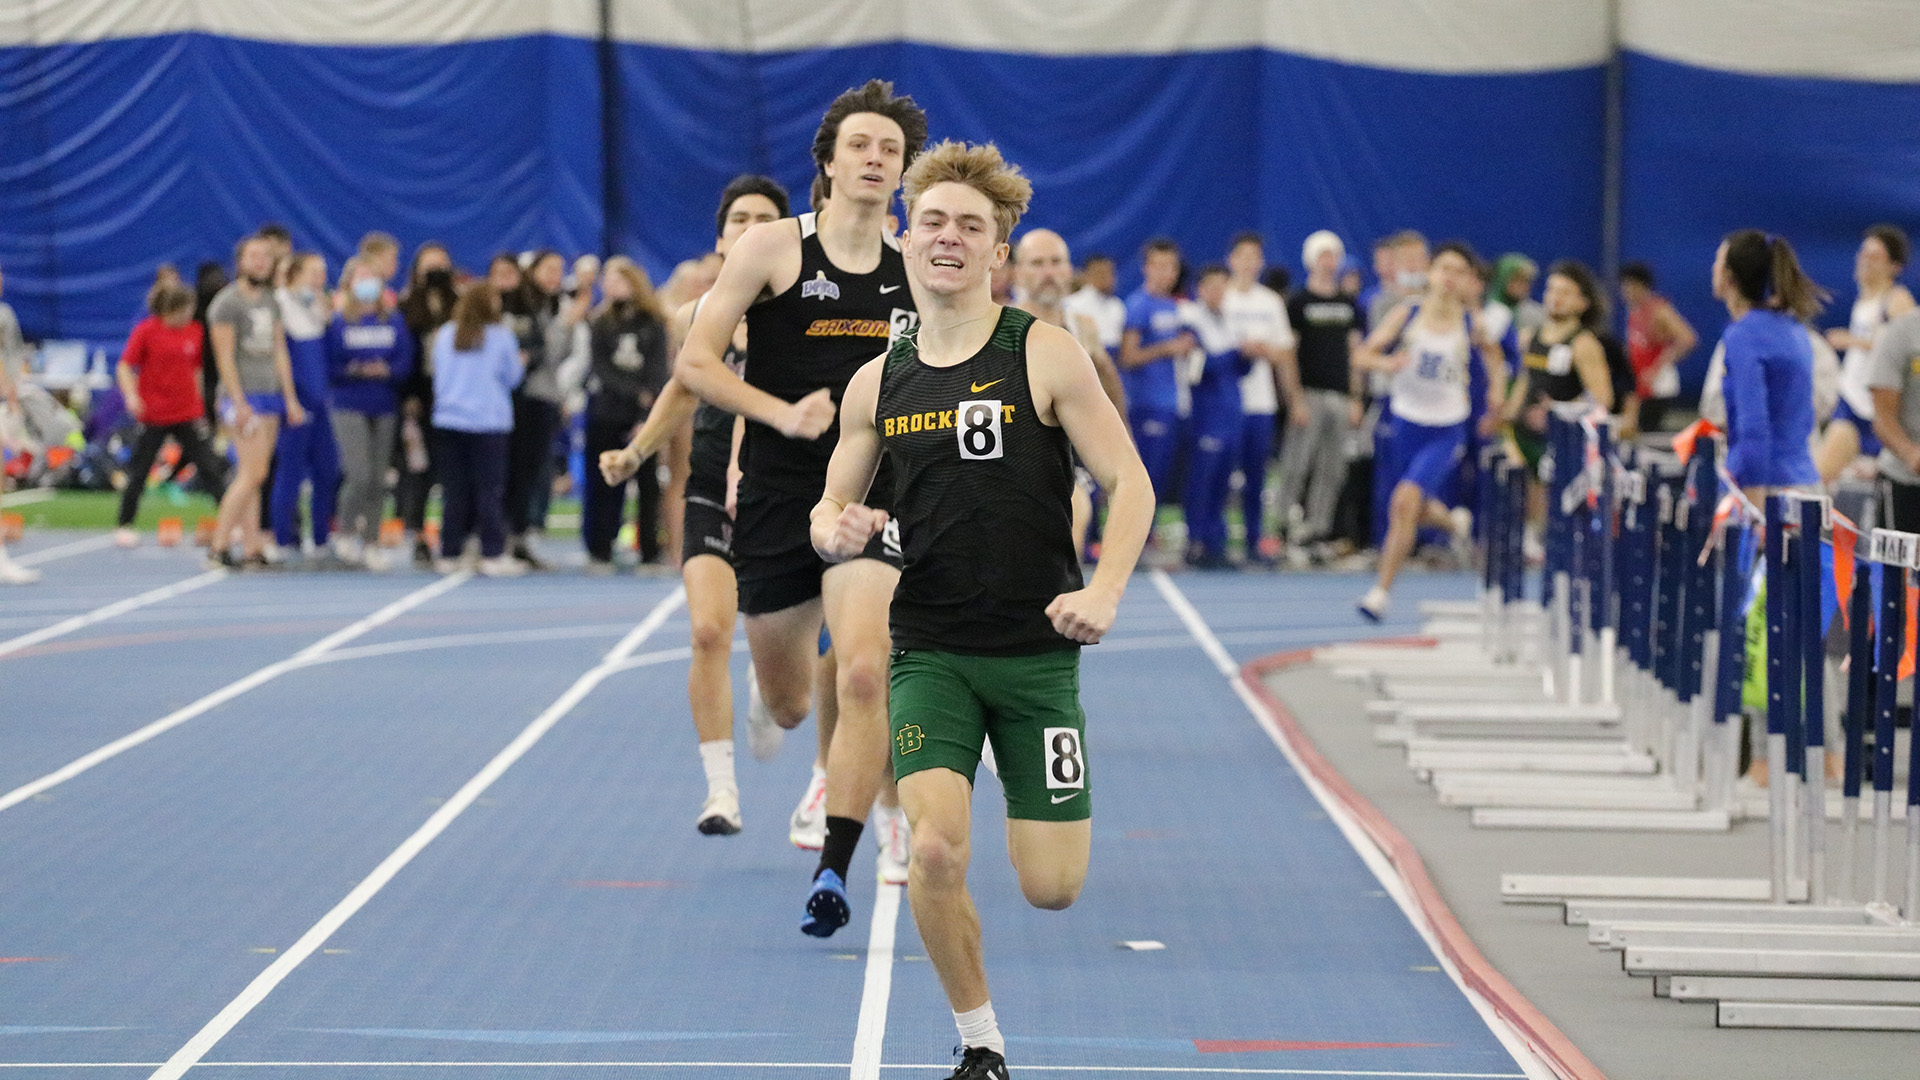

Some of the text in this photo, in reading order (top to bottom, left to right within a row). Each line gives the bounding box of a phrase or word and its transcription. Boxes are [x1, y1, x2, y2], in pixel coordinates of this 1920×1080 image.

[805, 319, 890, 338] SAXON
[884, 404, 1016, 437] BROCKT
[963, 404, 996, 456] 8
[1051, 732, 1081, 784] 8
